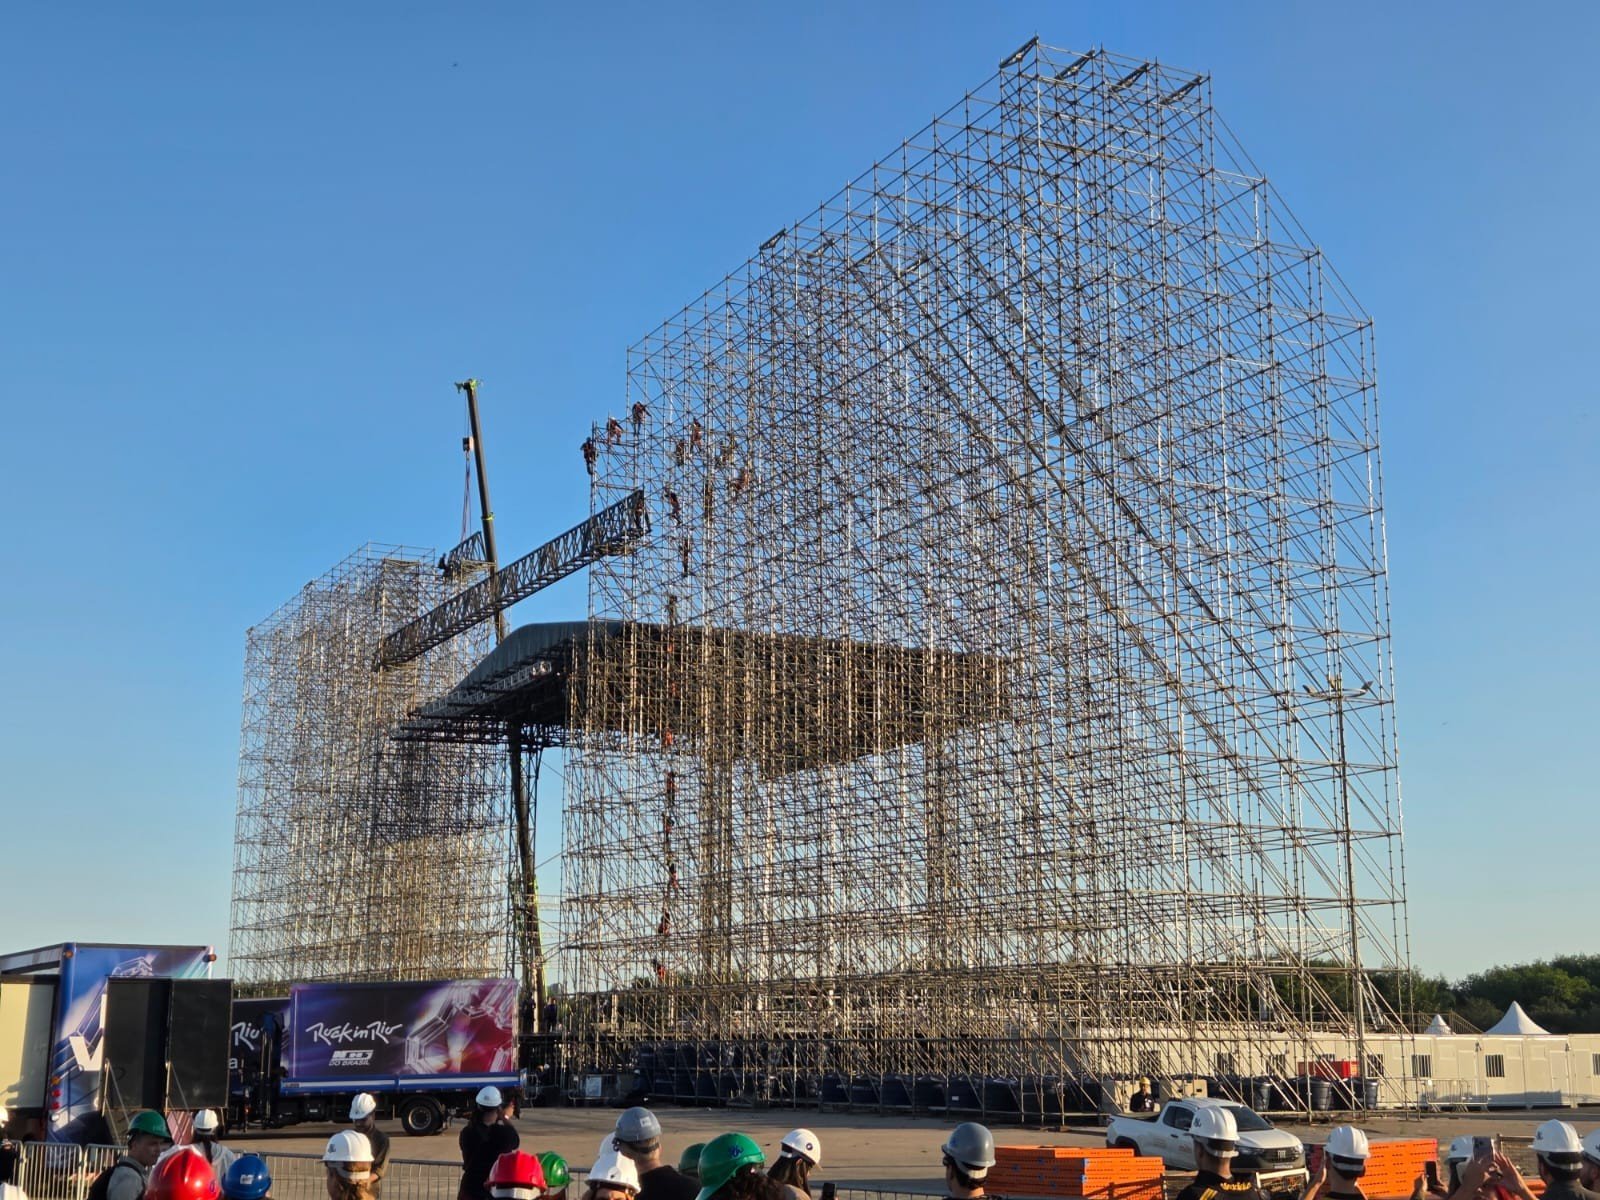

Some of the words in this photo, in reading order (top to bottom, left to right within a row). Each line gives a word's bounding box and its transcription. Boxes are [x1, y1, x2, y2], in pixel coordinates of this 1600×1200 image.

[231, 1021, 263, 1051] Rio
[305, 1022, 353, 1046] Rock
[353, 1026, 369, 1040] in
[366, 1020, 403, 1045] Rio
